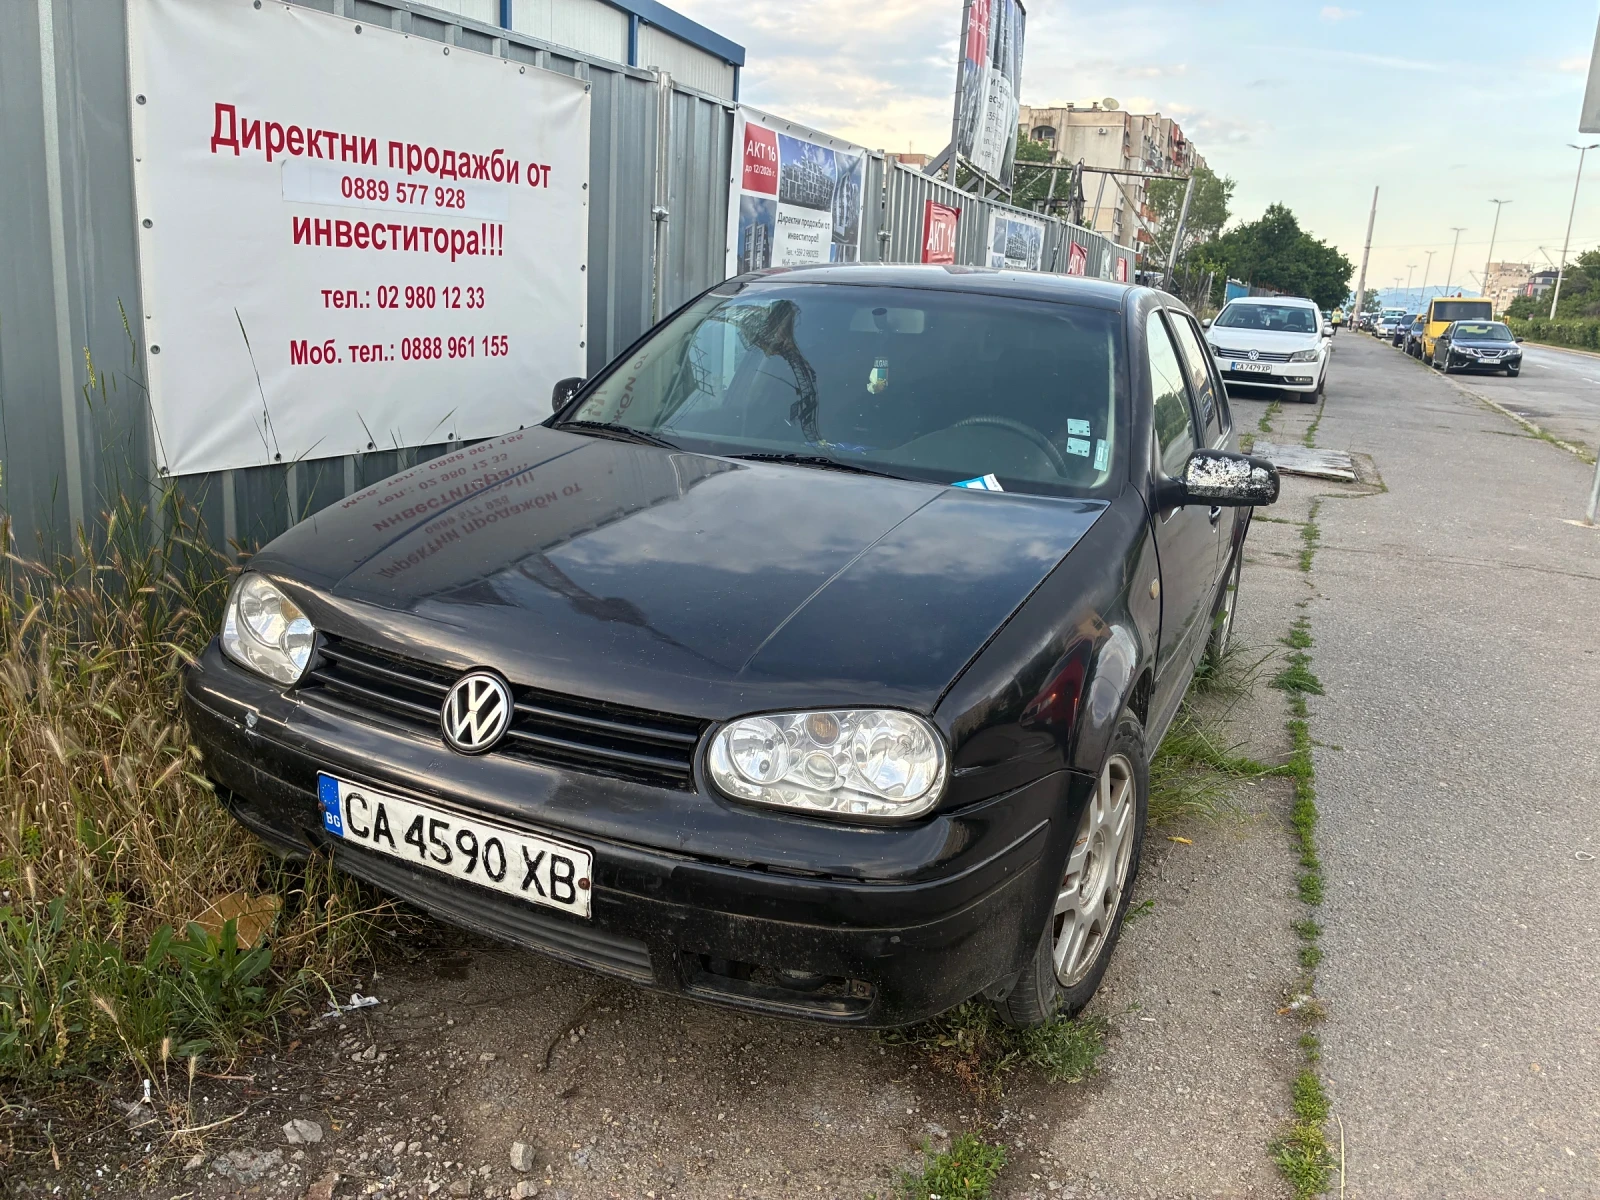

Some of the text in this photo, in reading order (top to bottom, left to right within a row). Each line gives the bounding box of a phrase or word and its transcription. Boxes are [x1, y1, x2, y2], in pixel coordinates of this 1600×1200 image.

[211, 102, 551, 188] Директни продажби от
[746, 139, 776, 162] АКТ 16
[341, 176, 466, 209] 0889 577 928
[777, 212, 801, 226] Директни
[292, 216, 504, 262] инвеститора!!!
[926, 220, 946, 252] АКТ
[321, 285, 485, 310] тел.: 02 980 12 33
[290, 335, 509, 365] Моб. тел.: 0888 961 155
[326, 792, 576, 905] BG CA 4590 XB
